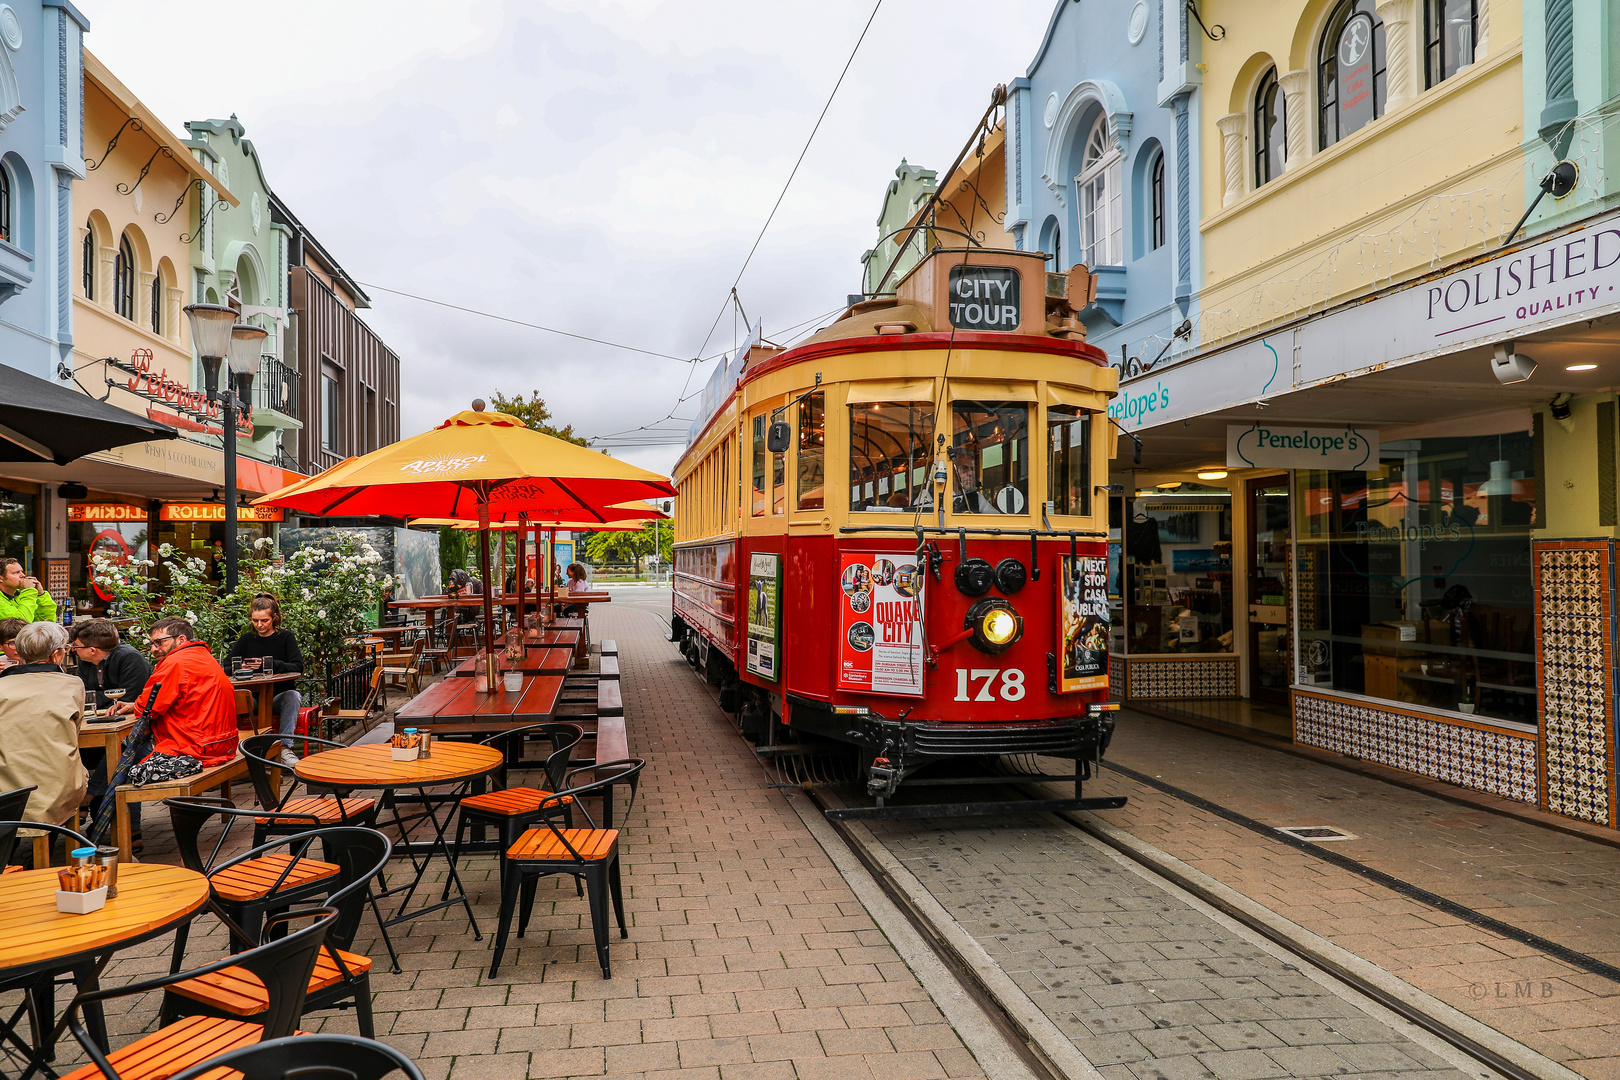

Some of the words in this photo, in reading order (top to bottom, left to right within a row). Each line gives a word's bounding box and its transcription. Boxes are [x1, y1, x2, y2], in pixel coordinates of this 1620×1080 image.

[1342, 63, 1369, 84] Canterbury
[1347, 78, 1364, 94] Cake
[1343, 89, 1370, 111] Supplies
[1427, 229, 1620, 321] POLISHED
[956, 278, 1011, 299] CITY
[1516, 285, 1600, 319] QUALITY
[949, 303, 1017, 325] TOUR
[1257, 429, 1358, 455] Penelope's
[400, 455, 487, 471] APEROL
[1355, 516, 1461, 549] Penelope's
[1084, 560, 1106, 572] NEXT
[1084, 575, 1106, 587] STOP
[1084, 589, 1107, 601] CASA
[876, 600, 920, 625] QUAKE
[1071, 603, 1108, 616] PUBLICA
[883, 621, 912, 643] CITY
[953, 668, 1026, 702] 178
